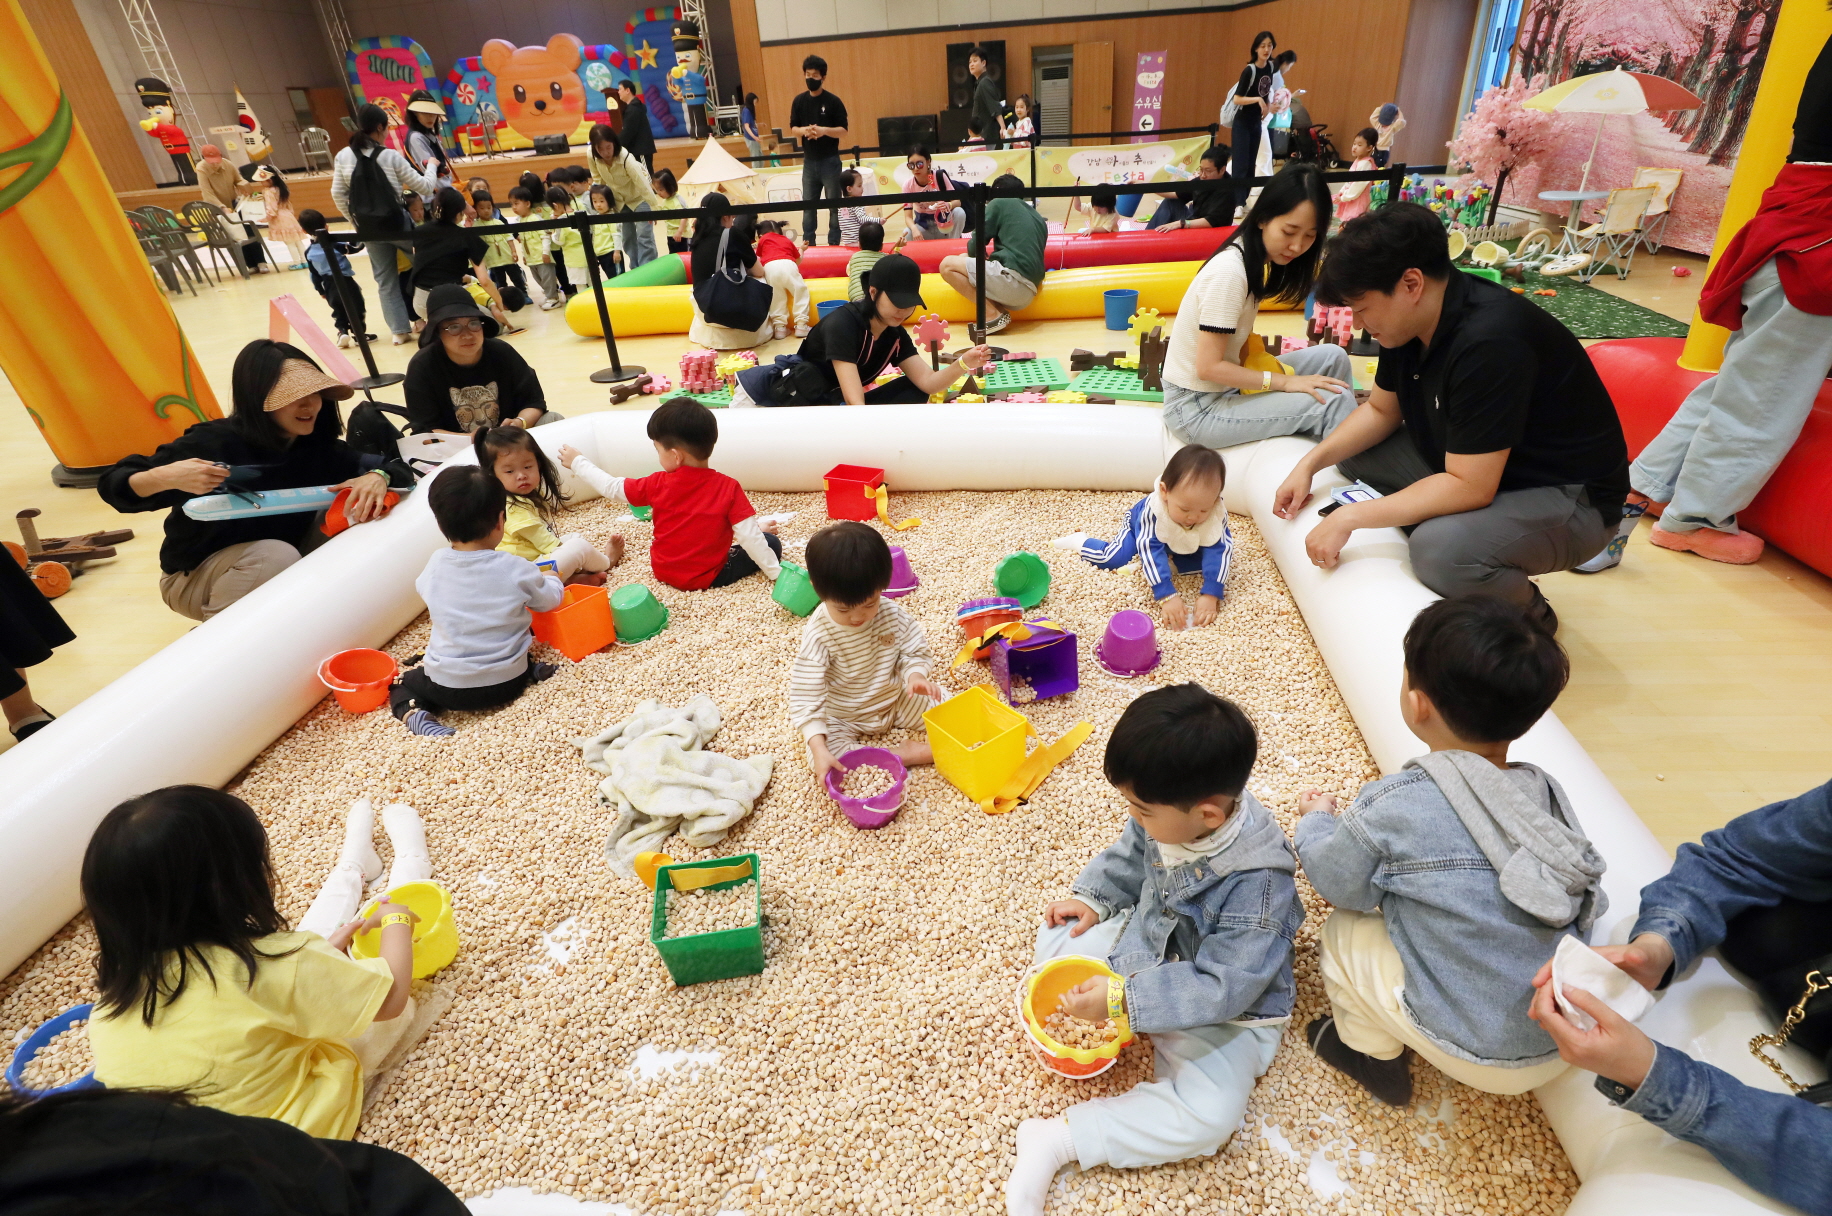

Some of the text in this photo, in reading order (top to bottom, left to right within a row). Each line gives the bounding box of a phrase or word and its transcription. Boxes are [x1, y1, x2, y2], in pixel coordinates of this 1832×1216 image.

[1134, 94, 1162, 110] 수유실
[1086, 158, 1102, 166] 강남
[1104, 171, 1145, 183] Festa
